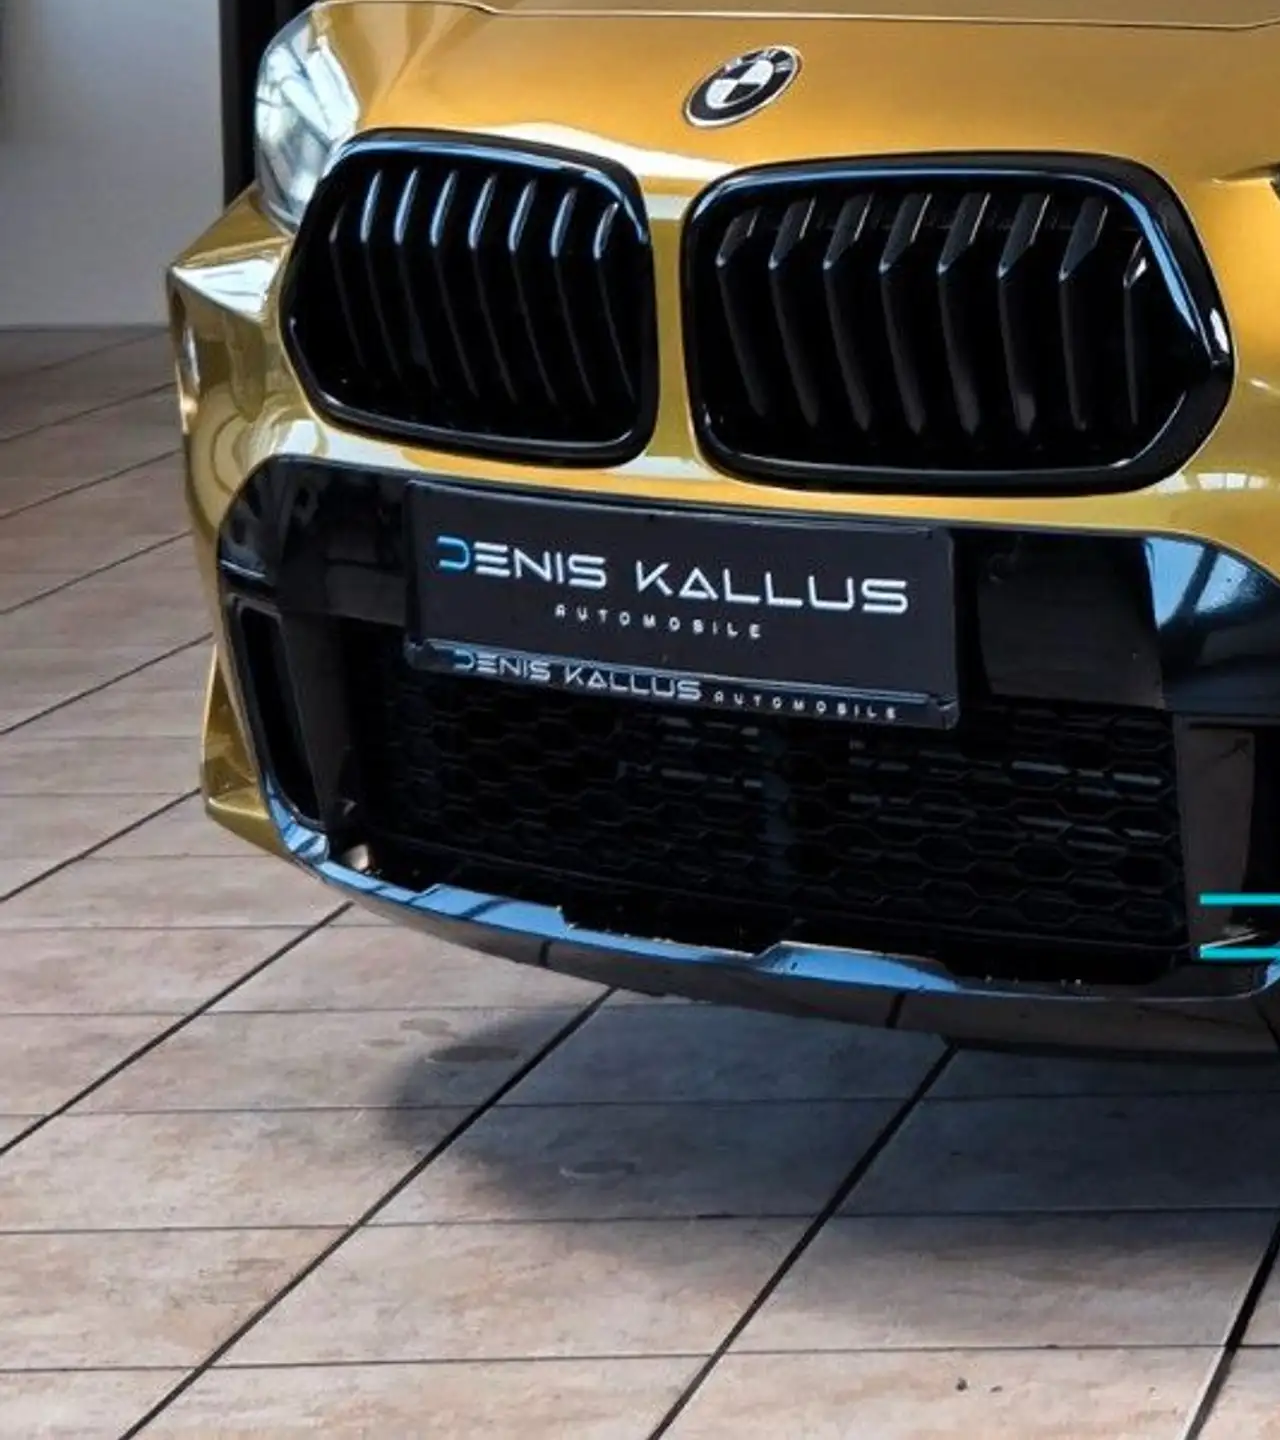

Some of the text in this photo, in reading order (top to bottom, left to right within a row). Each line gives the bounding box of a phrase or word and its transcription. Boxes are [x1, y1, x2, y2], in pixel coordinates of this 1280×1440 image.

[437, 535, 909, 615] DENIS KALLUS
[554, 604, 762, 639] AUTOMOBILE
[452, 648, 897, 721] DENIS KALLUS AUTOMOBILE
